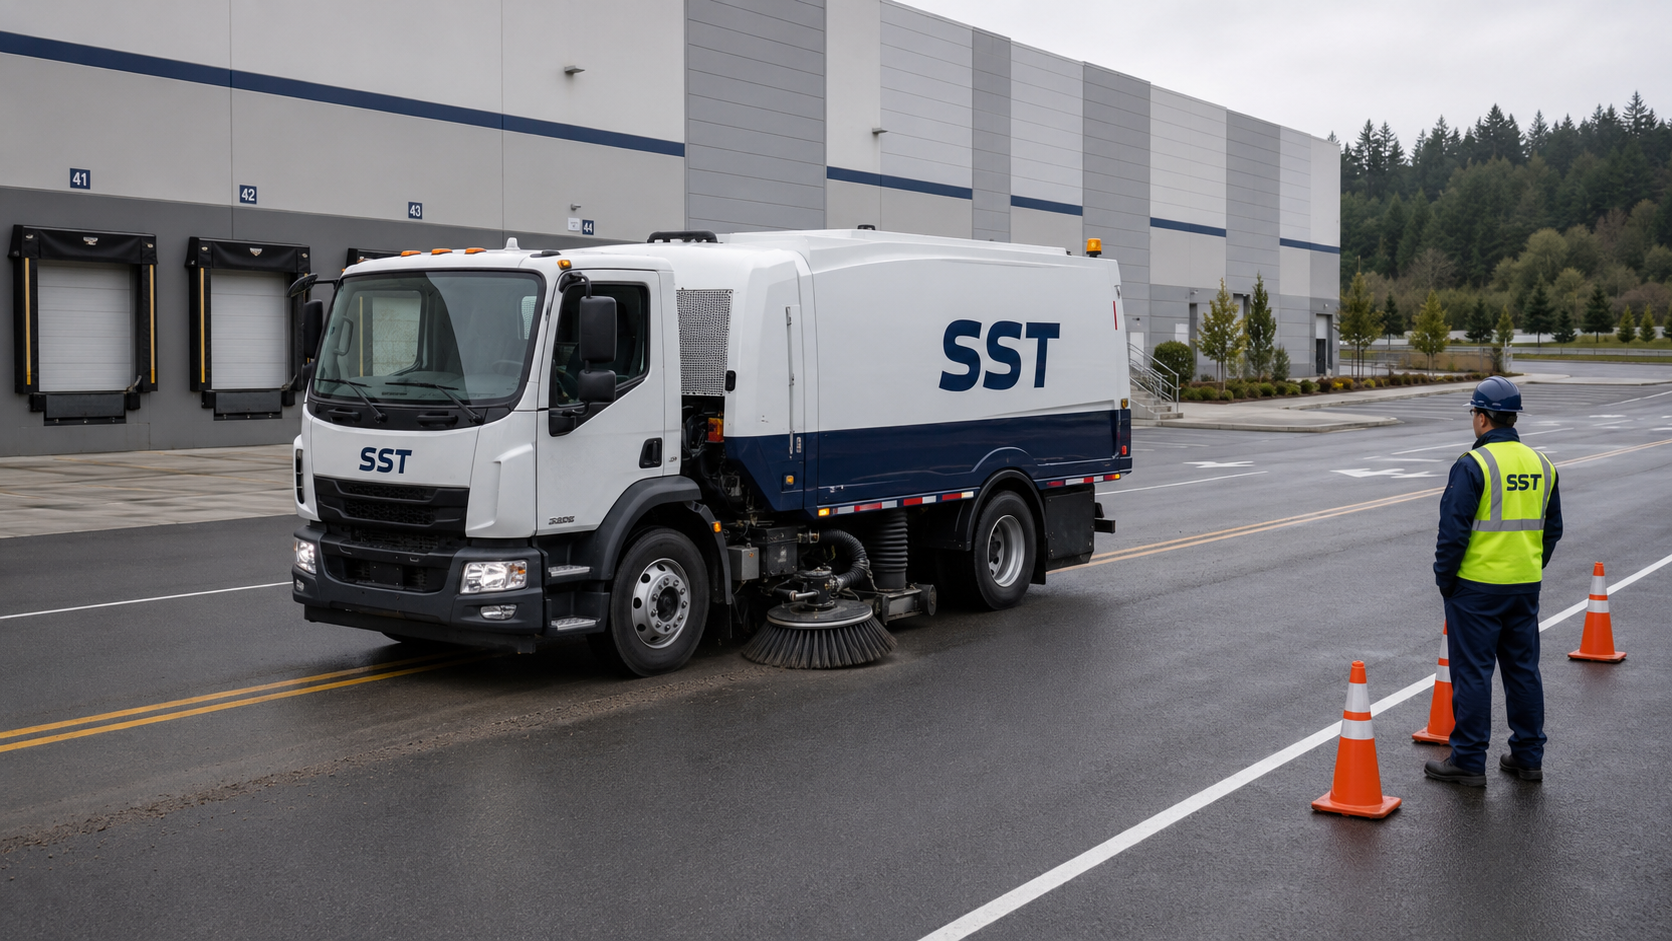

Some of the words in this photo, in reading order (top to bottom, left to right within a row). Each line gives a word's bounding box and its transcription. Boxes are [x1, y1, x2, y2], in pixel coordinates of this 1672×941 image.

[72, 172, 87, 187] 41
[241, 188, 255, 202] 42
[409, 204, 421, 217] 43
[583, 222, 593, 233] 44
[939, 320, 1061, 391] SST
[359, 447, 413, 474] SST
[1506, 473, 1542, 492] SST
